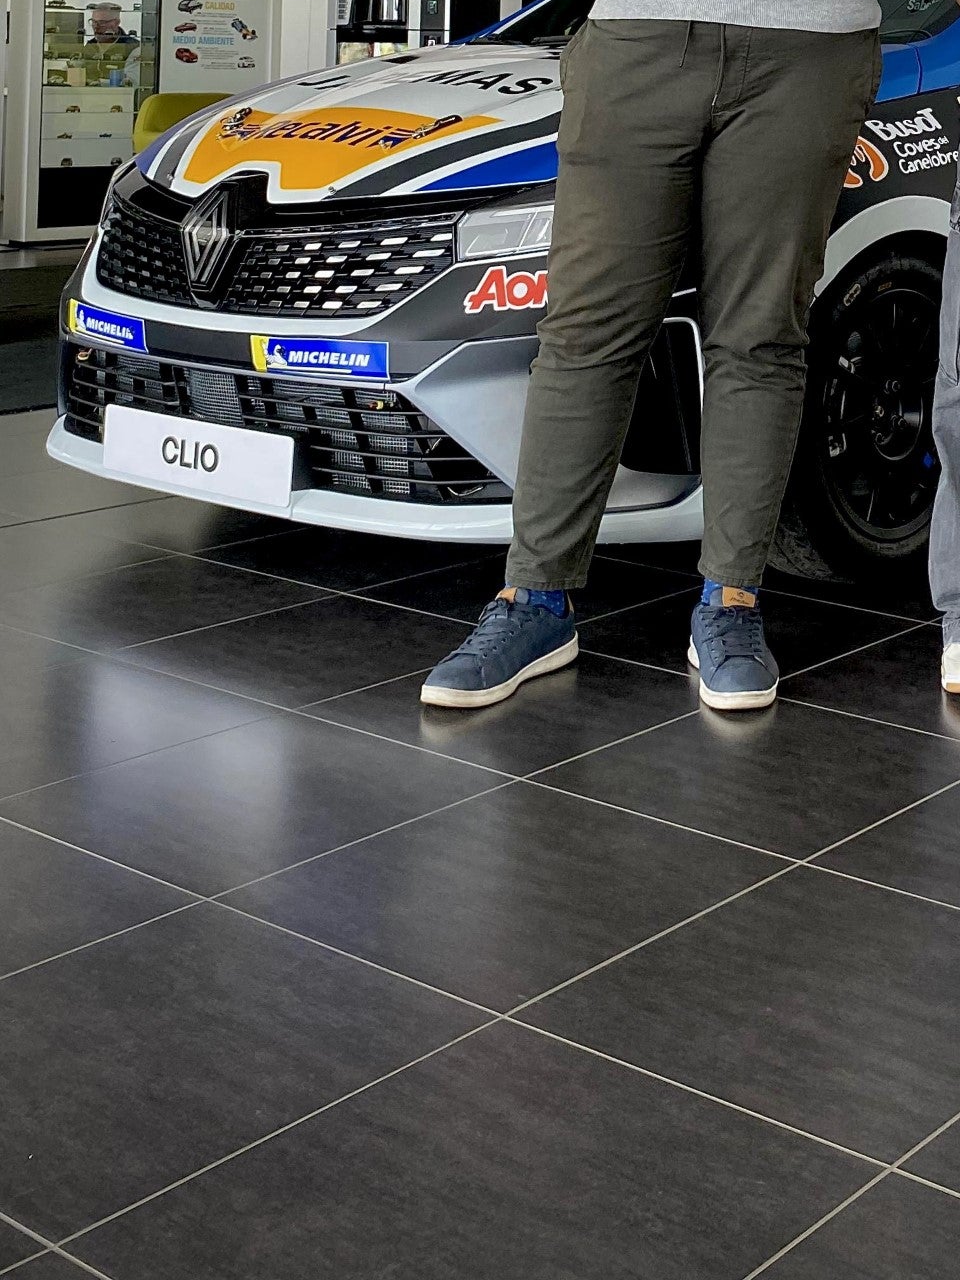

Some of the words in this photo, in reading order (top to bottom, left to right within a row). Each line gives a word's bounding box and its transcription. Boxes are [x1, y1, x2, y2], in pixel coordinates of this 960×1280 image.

[205, 1, 236, 11] CALIDAD
[172, 35, 197, 45] MEDIO
[198, 36, 235, 46] AMBIENTE
[893, 138, 940, 158] Coves
[938, 135, 949, 145] del
[899, 151, 959, 174] Canelobre
[86, 316, 134, 340] MICHELIN
[288, 350, 371, 368] MICHELIN
[162, 436, 219, 473] CLIO
